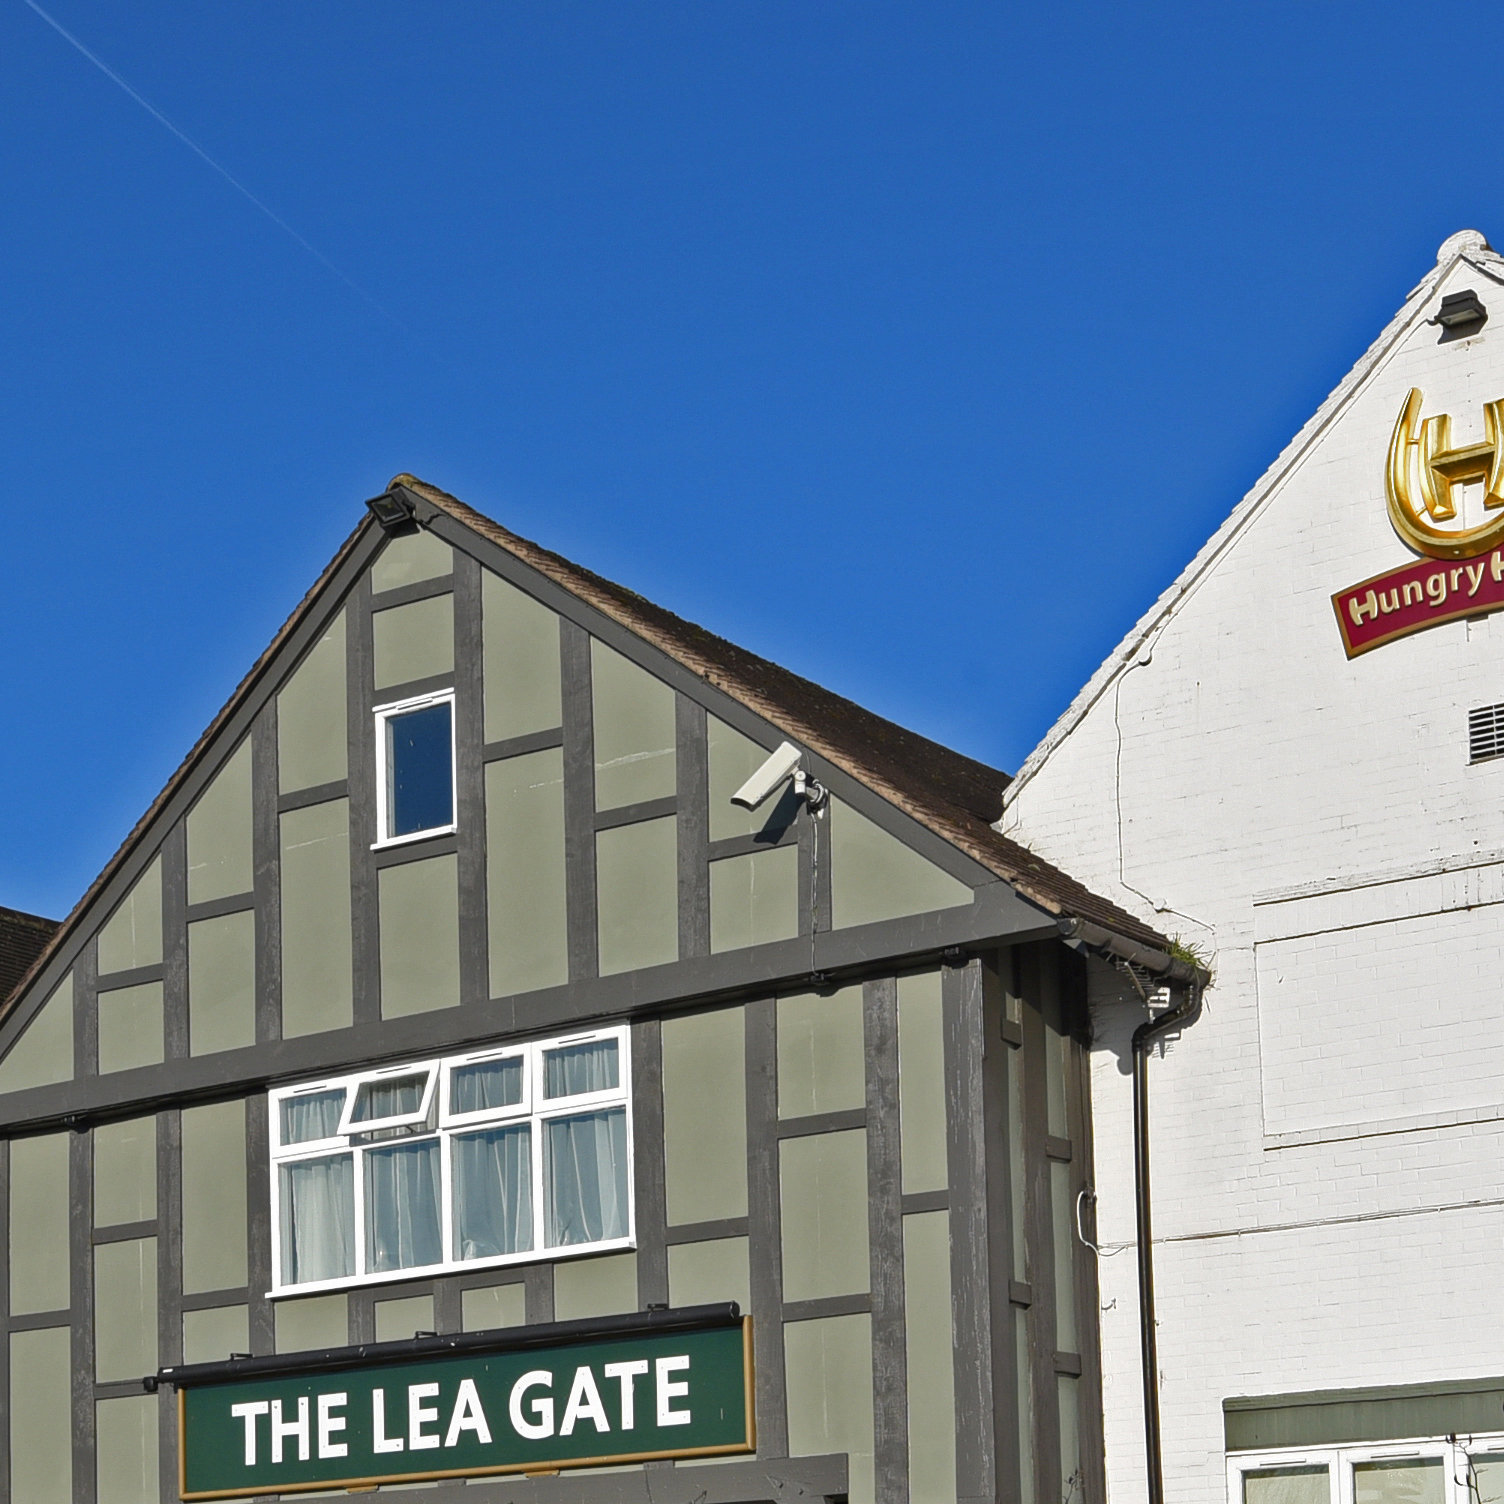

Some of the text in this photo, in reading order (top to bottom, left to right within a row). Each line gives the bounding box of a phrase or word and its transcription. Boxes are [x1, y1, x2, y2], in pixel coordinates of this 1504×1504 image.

[1348, 562, 1486, 627] Hungry
[231, 1355, 691, 1466] THE LEA GATE
